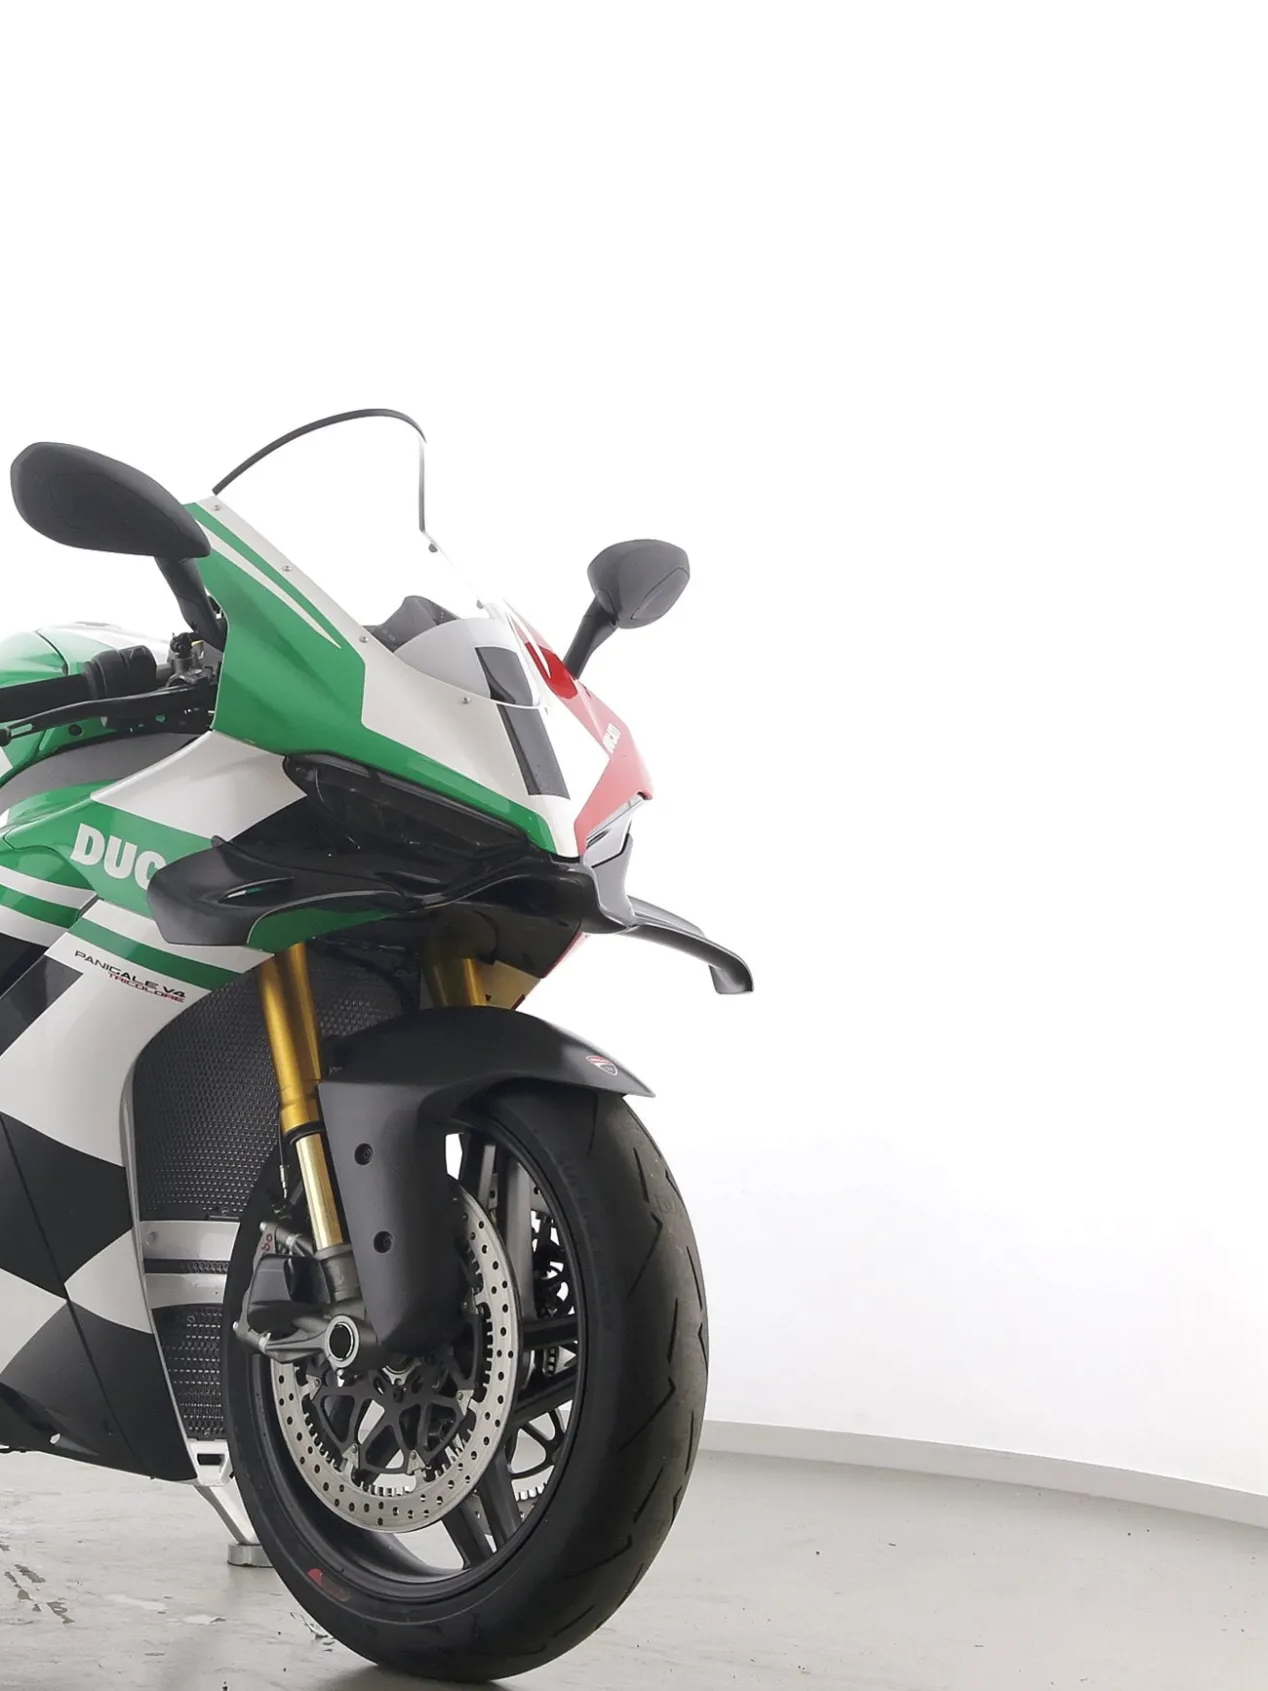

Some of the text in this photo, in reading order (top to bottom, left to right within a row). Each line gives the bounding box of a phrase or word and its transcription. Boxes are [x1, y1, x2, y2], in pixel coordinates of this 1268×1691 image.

[75, 950, 186, 998] PANIGALE V4
[108, 972, 184, 1003] TRICOLORE
